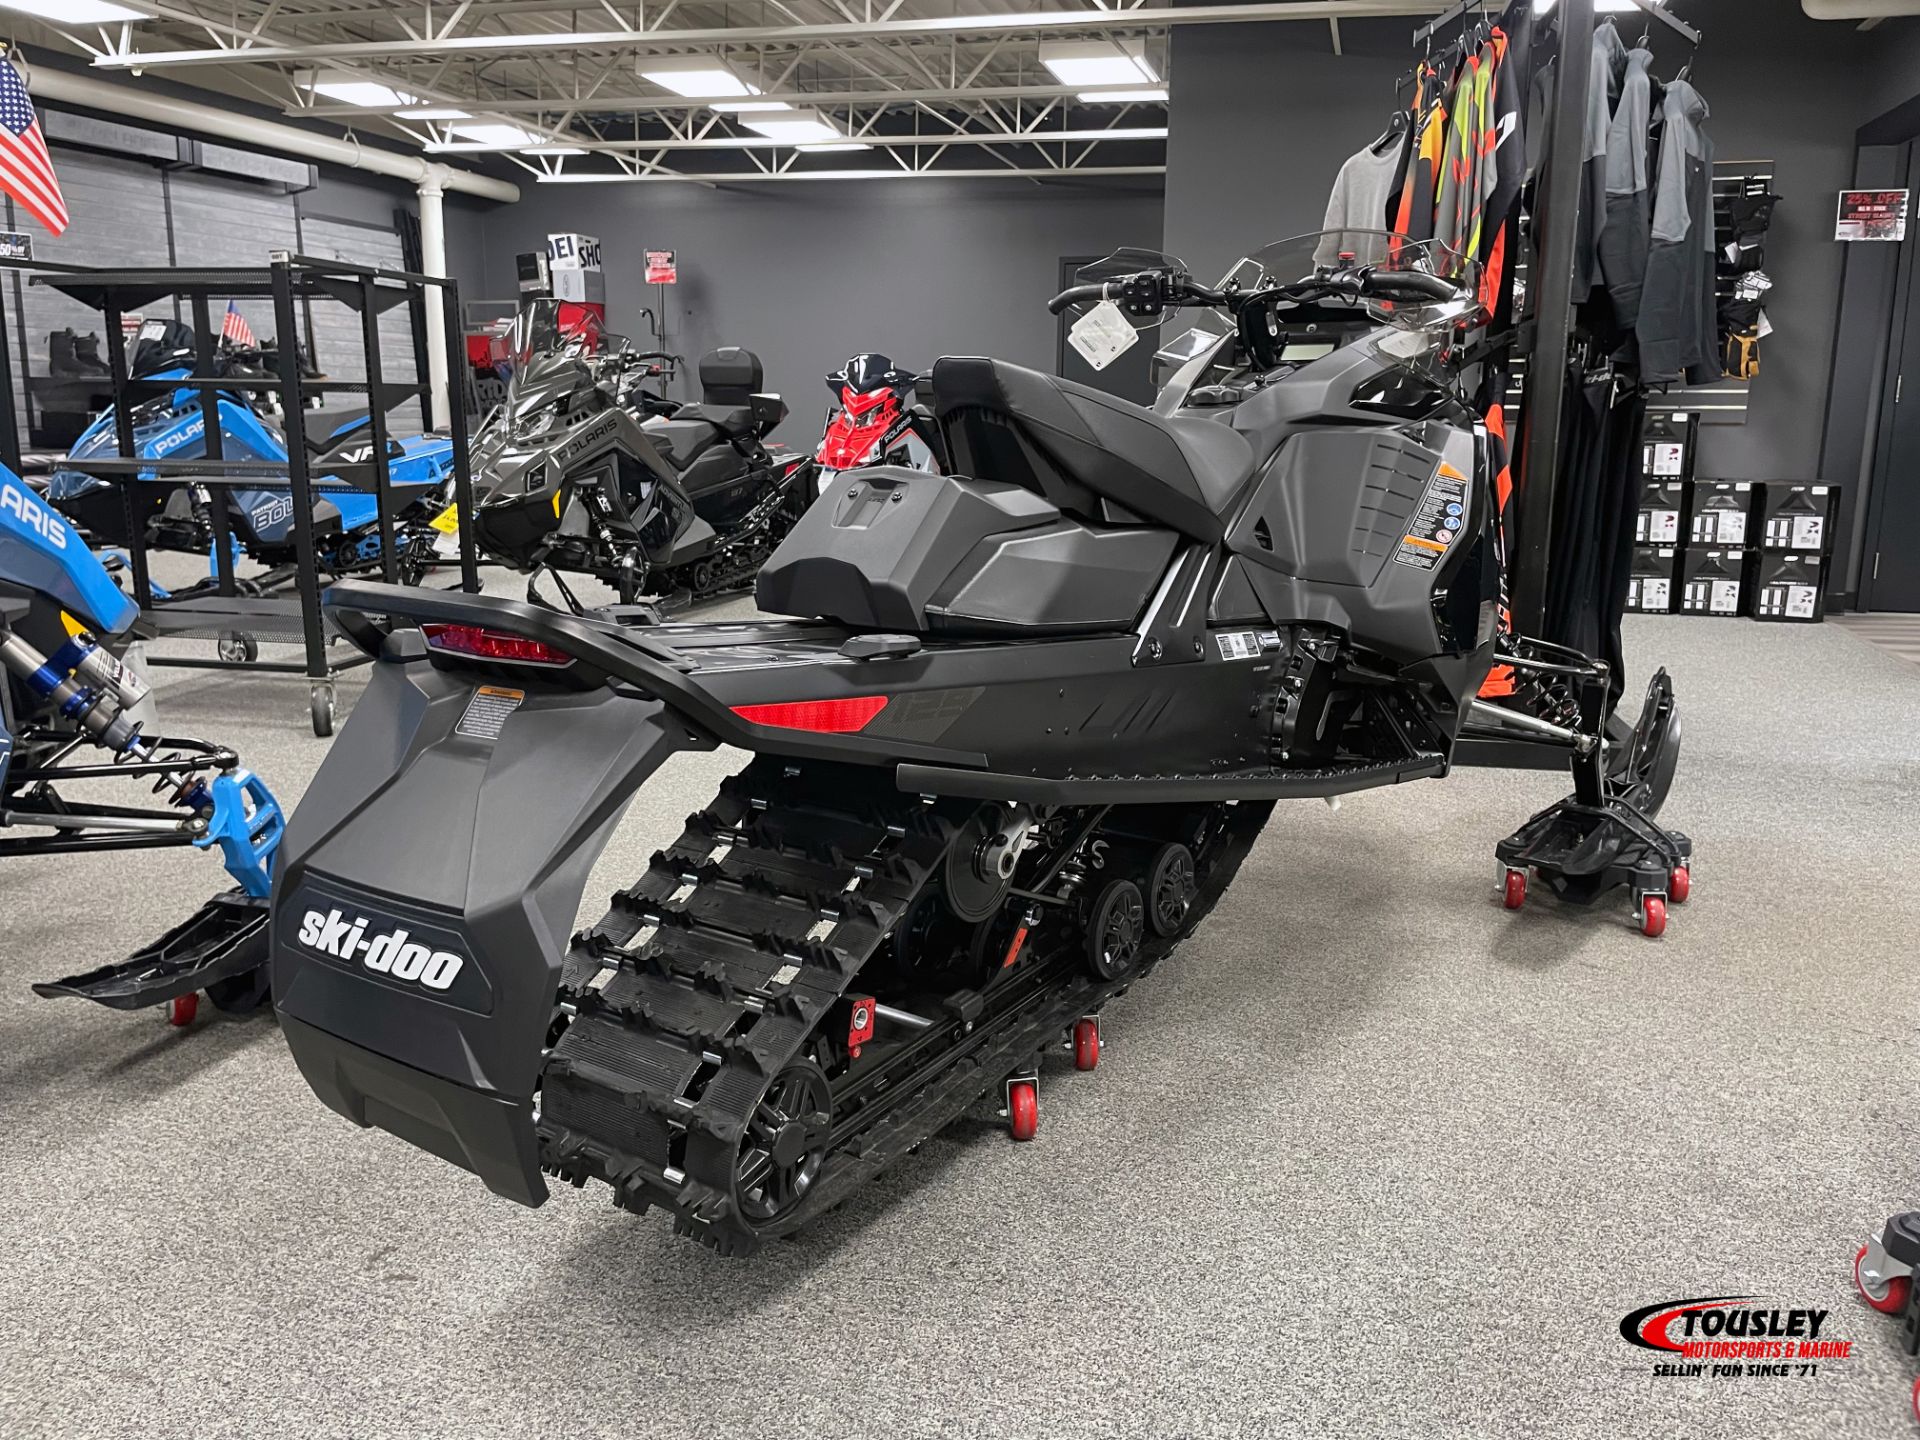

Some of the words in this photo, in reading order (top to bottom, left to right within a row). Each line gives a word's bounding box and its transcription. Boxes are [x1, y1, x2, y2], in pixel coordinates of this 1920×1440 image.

[558, 418, 618, 460] POLARIS
[884, 415, 912, 443] POLARIS
[298, 909, 464, 990] ski-doo
